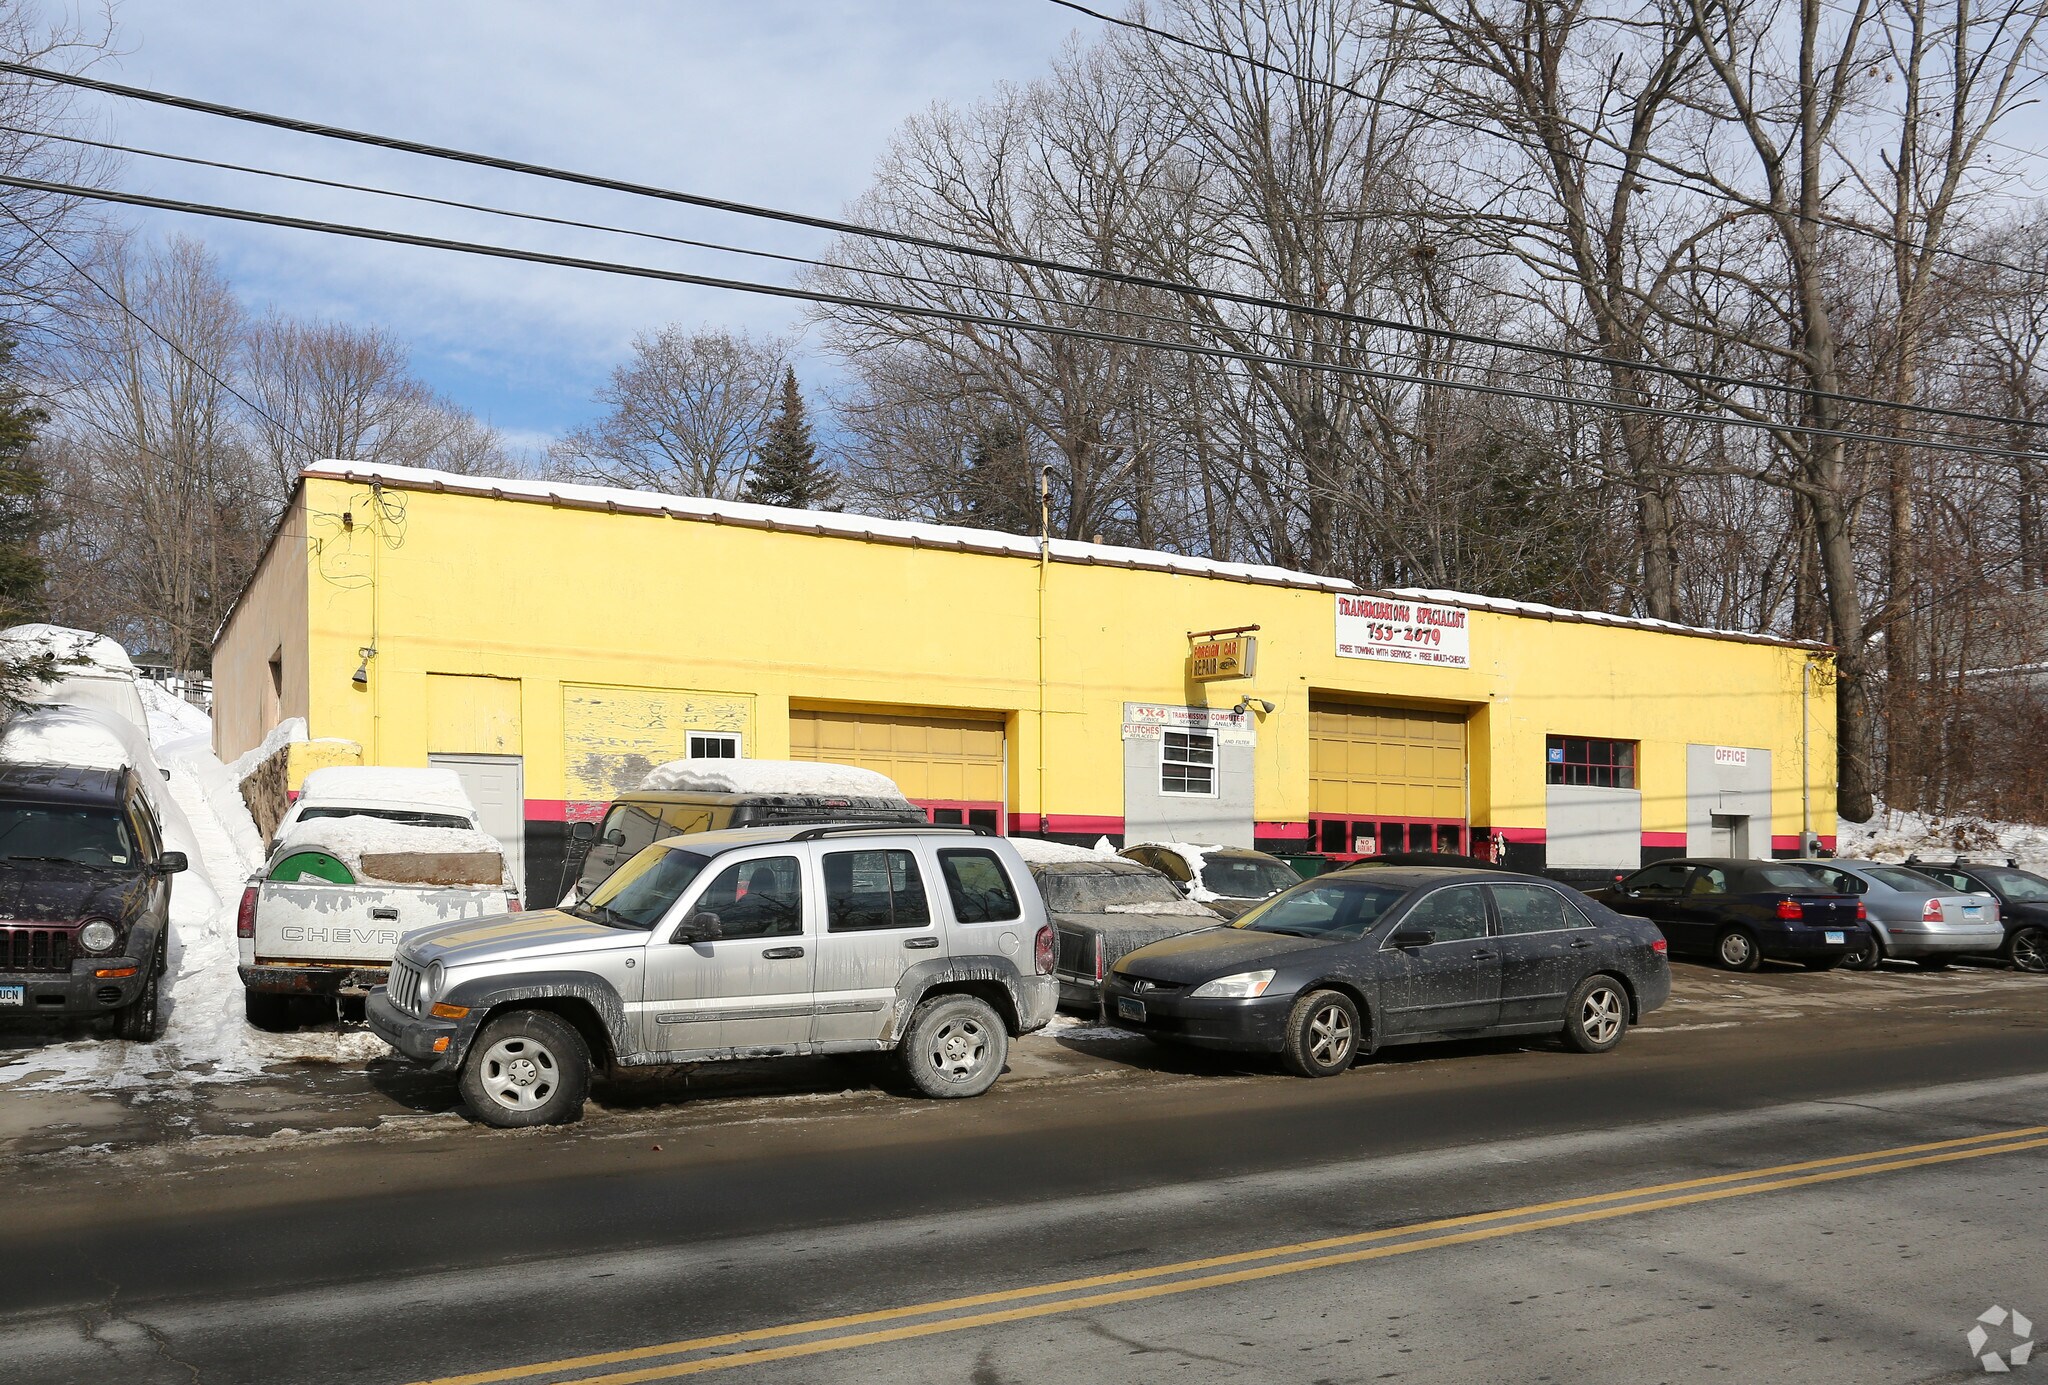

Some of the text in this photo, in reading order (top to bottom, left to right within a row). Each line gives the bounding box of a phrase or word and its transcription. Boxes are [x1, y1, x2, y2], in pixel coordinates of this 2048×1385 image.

[1338, 597, 1465, 628] TRANSMISSIONS SPECIALIST
[1366, 621, 1441, 646] 753-2079
[1194, 641, 1237, 659] FOREIGN CAR
[1339, 644, 1466, 664] FREE TOWING WITH SERVICE FREE MULTI-CHECK
[1194, 658, 1217, 676] REPAIR
[1172, 711, 1207, 720] TRANSMISSION
[1210, 713, 1245, 722] COMPUTER
[1124, 725, 1160, 735] CLUTCHES
[1716, 749, 1745, 762] OFFICE
[281, 926, 409, 944] CHEVR
